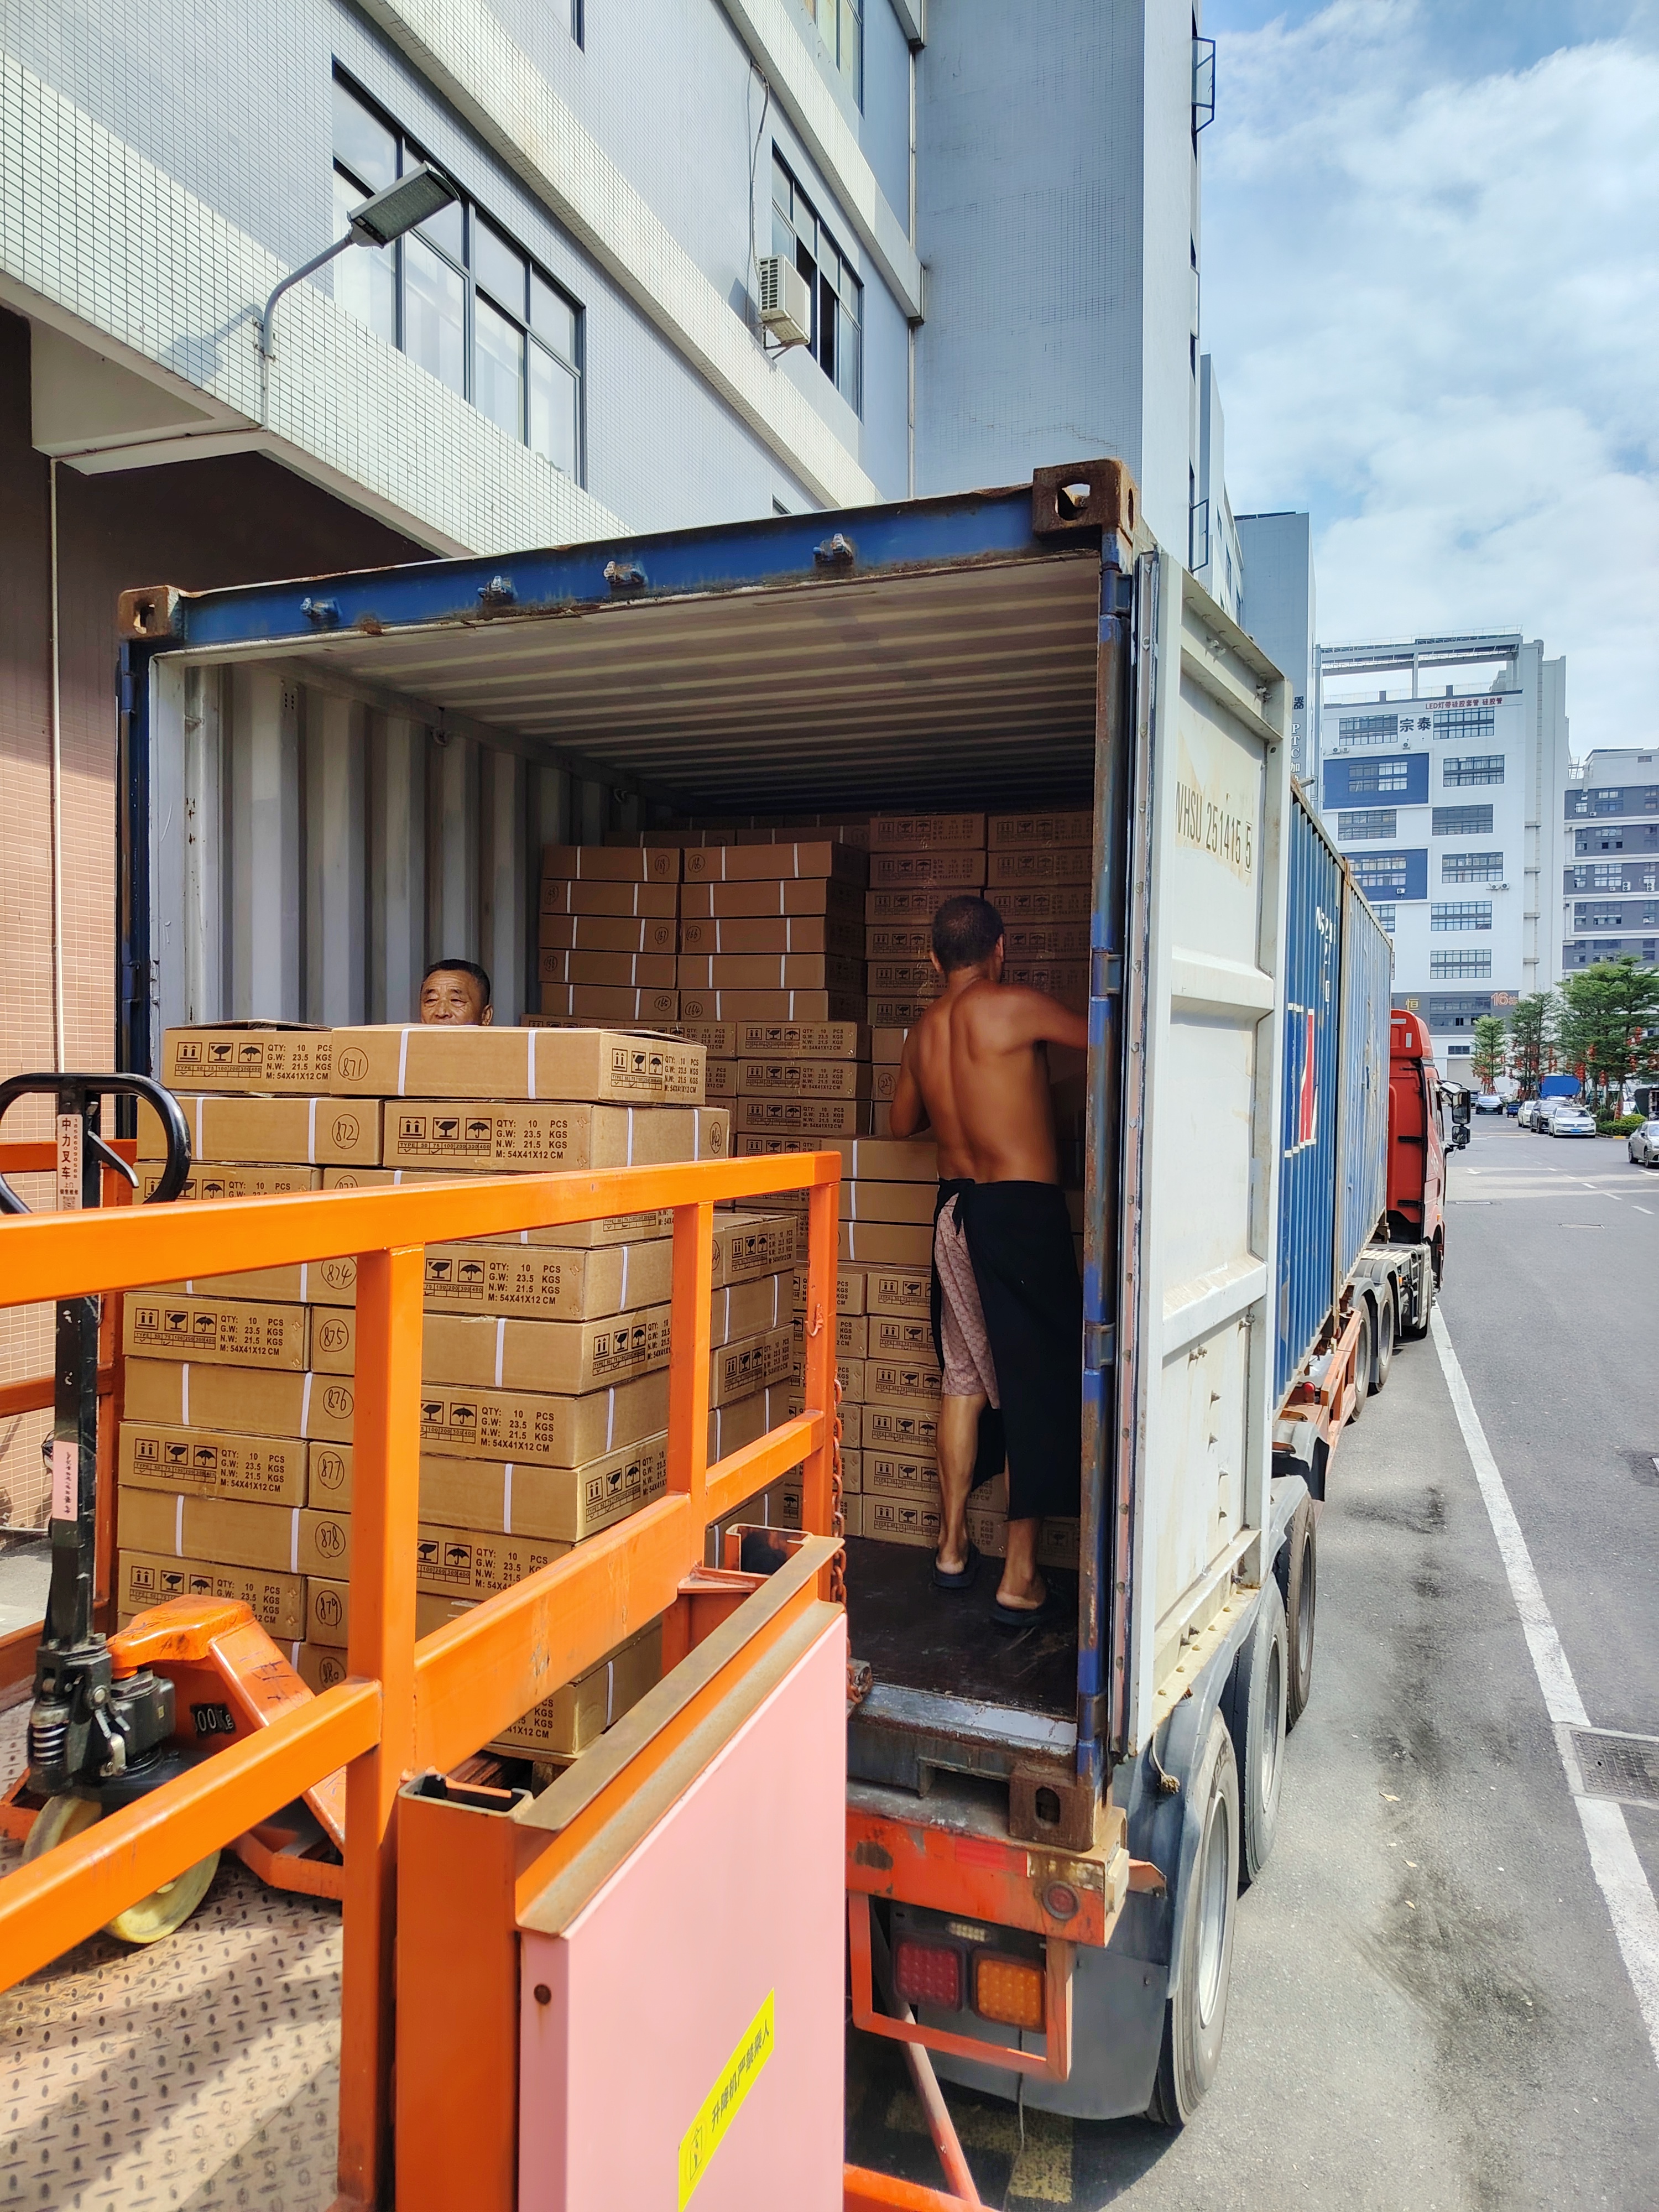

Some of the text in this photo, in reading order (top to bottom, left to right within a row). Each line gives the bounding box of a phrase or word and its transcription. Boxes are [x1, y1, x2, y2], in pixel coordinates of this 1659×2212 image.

[1400, 717, 1432, 732] 宗泰
[1176, 781, 1251, 869] VHSU 251415 5
[61, 1118, 71, 1180] 中力叉车
[500, 1295, 540, 1303] 54X41X12
[648, 1322, 658, 1331] QTY:
[230, 1345, 266, 1354] 54X41X12
[482, 1407, 502, 1416] QTY:
[536, 1412, 554, 1421] PCS
[482, 1418, 554, 1431] G.W: 23.5 KGS
[481, 1428, 500, 1437] N.W:
[535, 1433, 554, 1442] KGS
[493, 1439, 534, 1451] 54X41X12
[536, 1444, 549, 1452] CM
[221, 1459, 238, 1468] G.W:
[231, 1480, 267, 1490] 54X41X12
